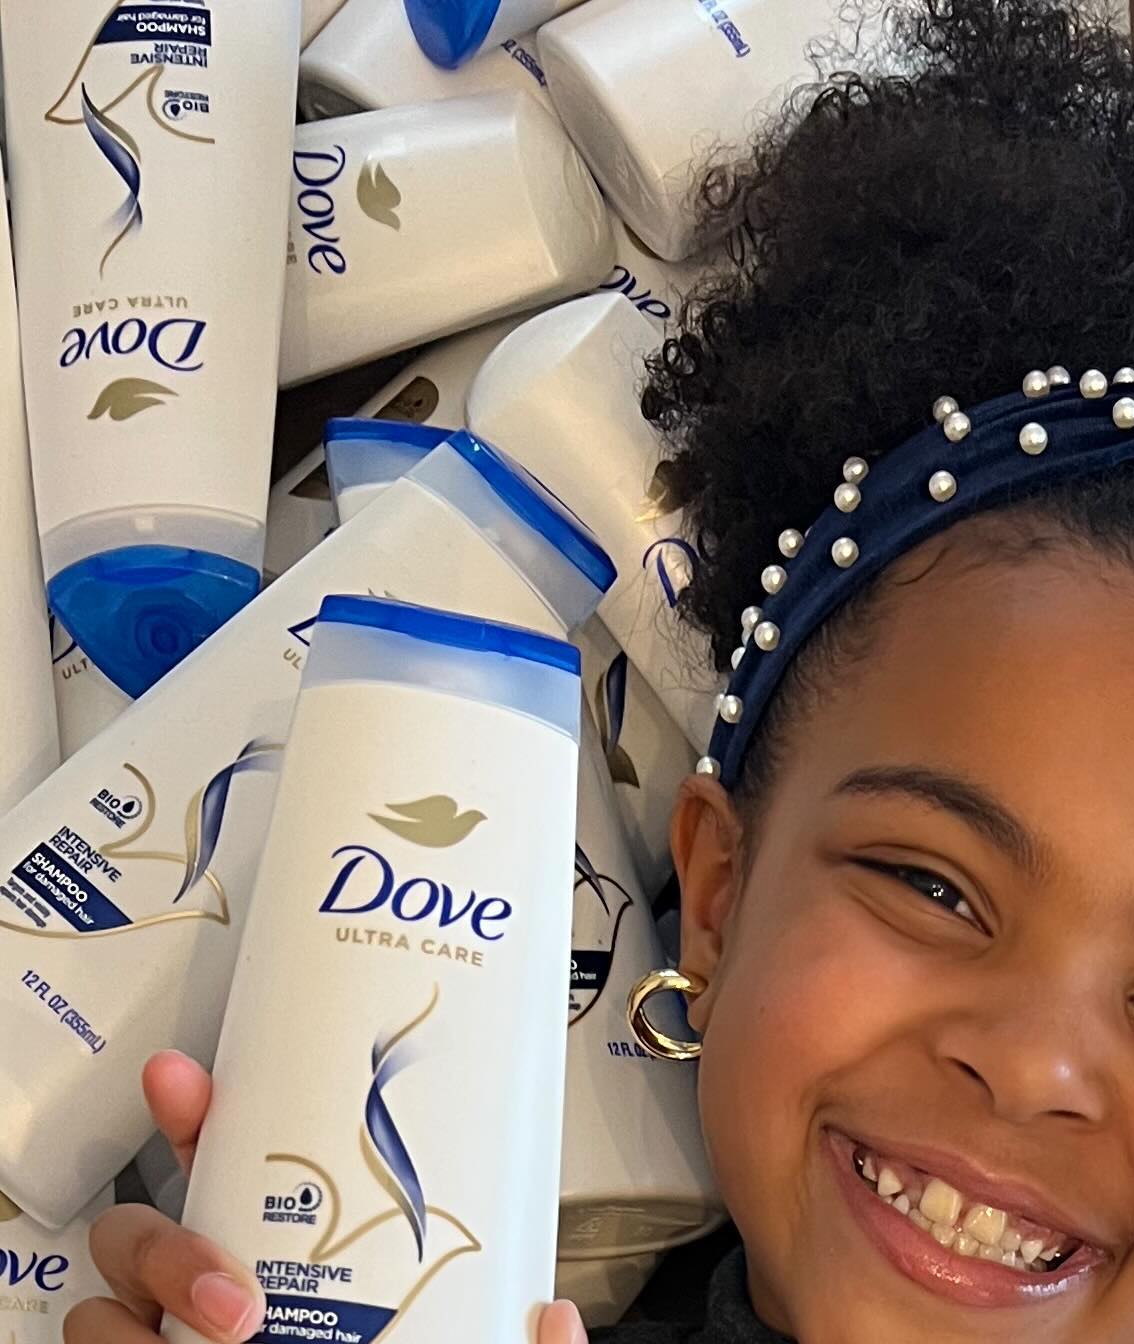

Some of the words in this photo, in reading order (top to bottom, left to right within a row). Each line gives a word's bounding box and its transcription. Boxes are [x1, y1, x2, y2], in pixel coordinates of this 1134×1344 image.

[136, 22, 206, 36] SHAMPOO
[154, 42, 208, 56] REPAIR
[130, 53, 208, 68] INTENSIVE
[292, 144, 346, 275] Dove
[73, 298, 119, 317] CARE
[127, 296, 188, 308] ULTRA
[59, 318, 207, 372] Dove
[97, 788, 120, 810] BIO
[49, 834, 94, 876] REPAIR
[58, 826, 122, 883] INTENSIVE
[31, 852, 88, 904] SHAMPOO
[34, 870, 80, 917] damaged
[72, 904, 96, 928] hair
[318, 844, 512, 941] Dove
[335, 926, 410, 951] ULTRA
[420, 939, 484, 968] CARE
[21, 970, 38, 989] 12
[35, 982, 50, 999] FL
[48, 992, 64, 1012] OZ
[60, 1006, 107, 1056] (355mL)
[608, 1042, 620, 1058] 12
[264, 1196, 296, 1212] BIO
[262, 1212, 316, 1225] RESTORE
[256, 1260, 353, 1282] INTENSIVE
[257, 1275, 319, 1294] REPAIR
[269, 1322, 332, 1342] damaged
[336, 1328, 362, 1344] hair
